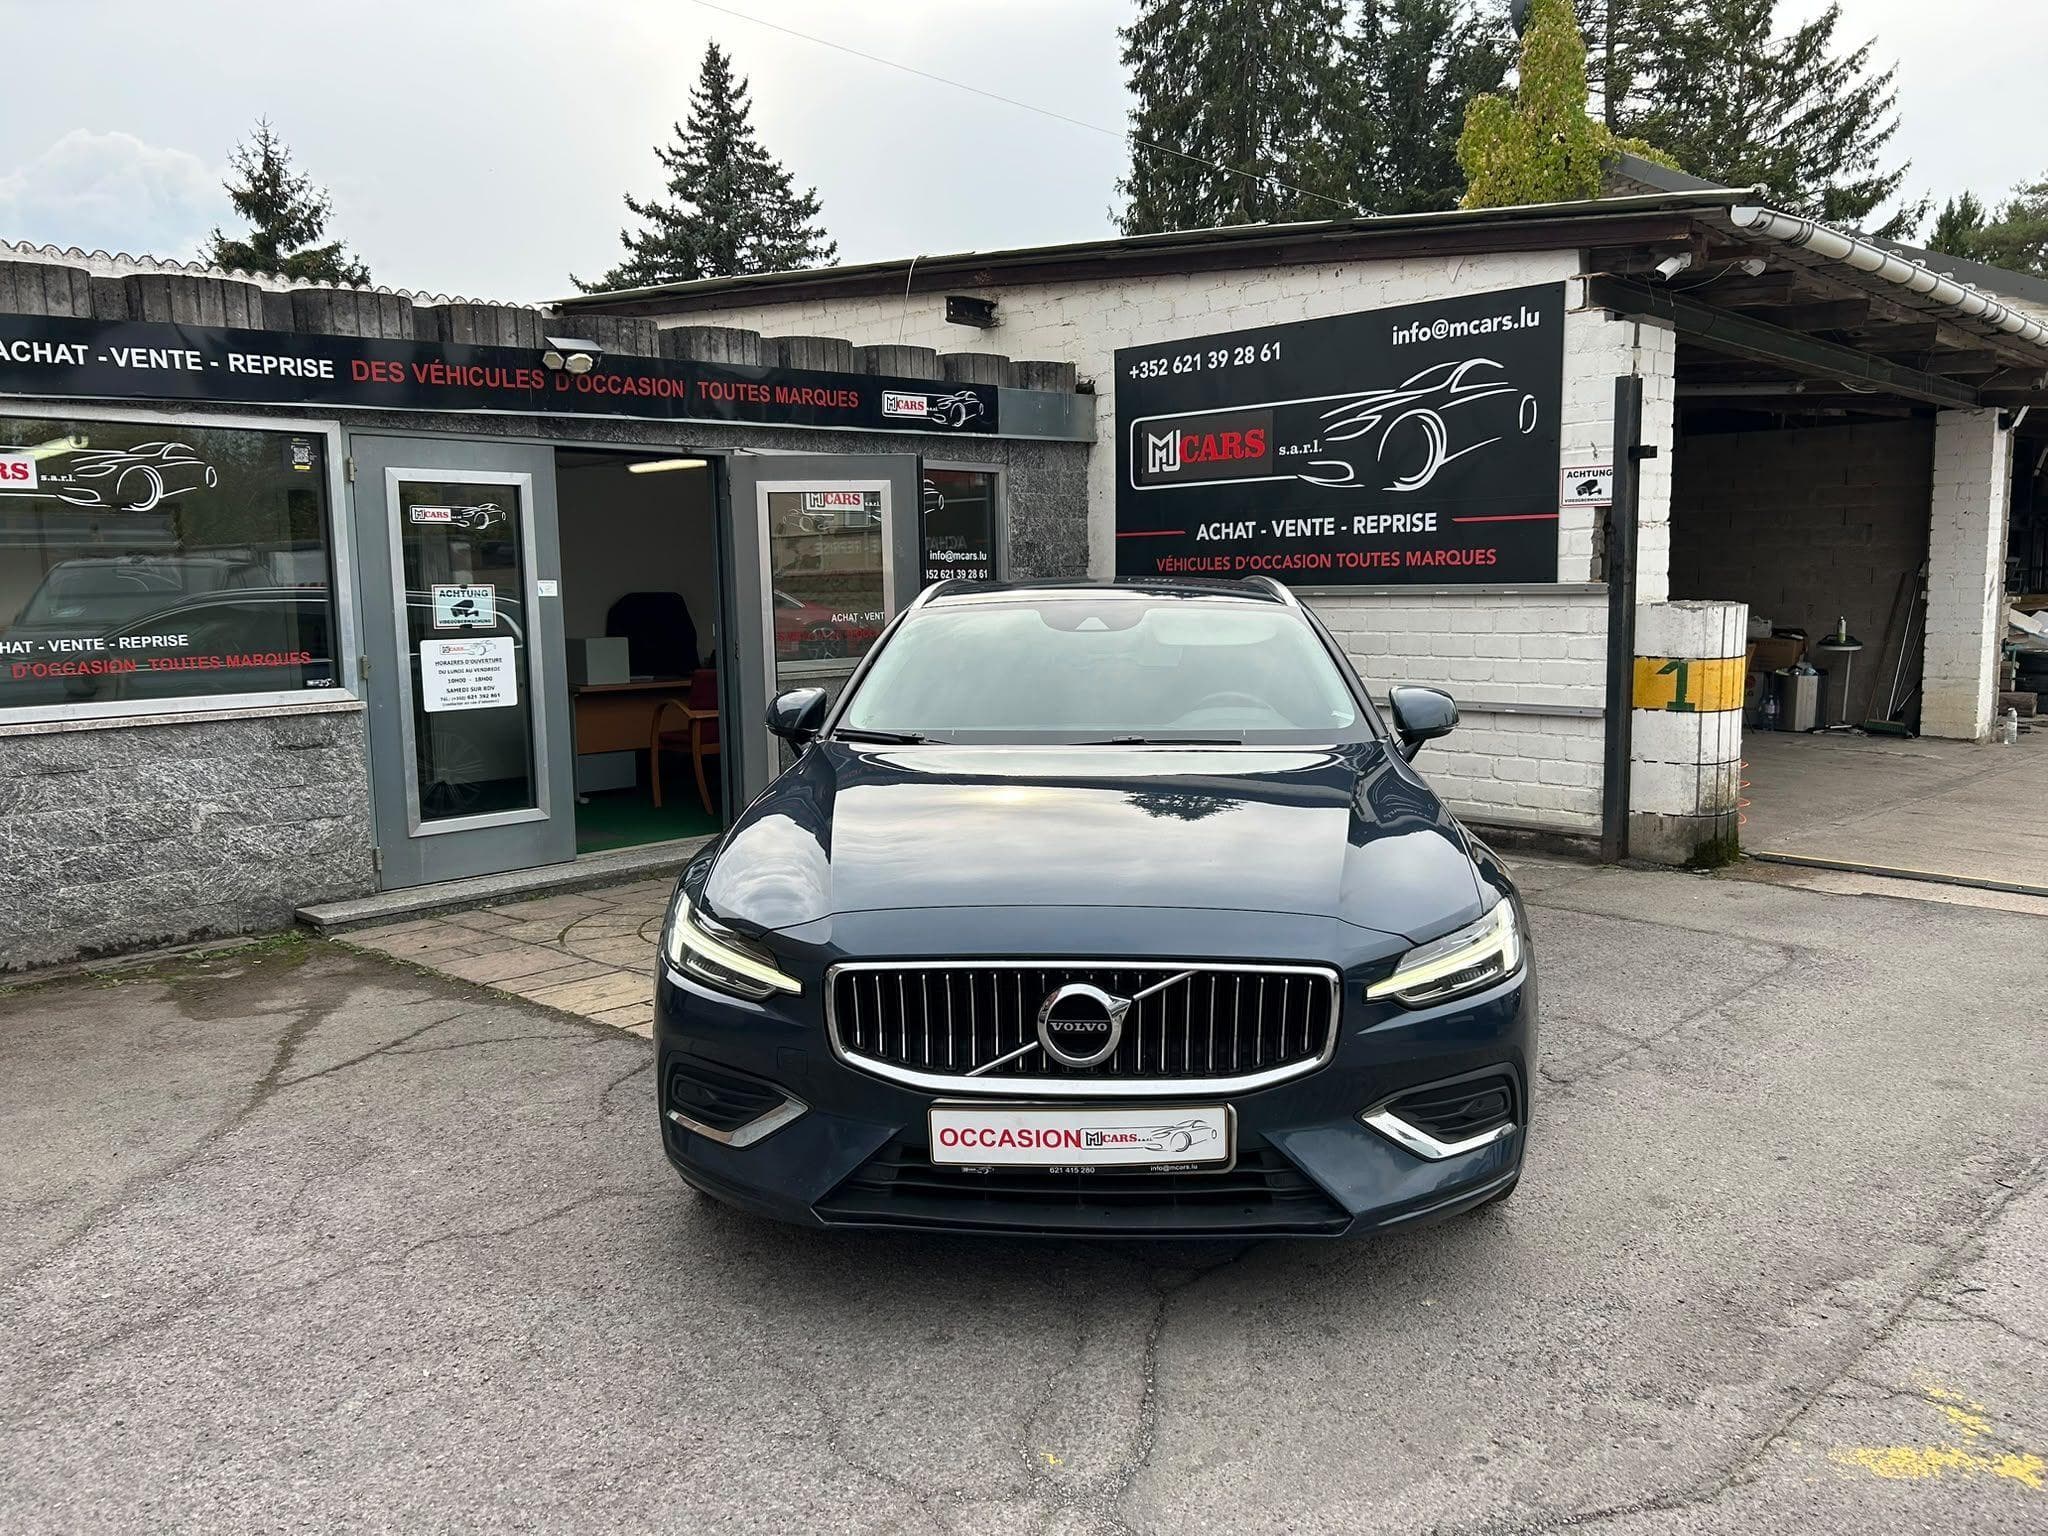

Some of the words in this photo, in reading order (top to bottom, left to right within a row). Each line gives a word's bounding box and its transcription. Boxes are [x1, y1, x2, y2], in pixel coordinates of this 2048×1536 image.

[1392, 306, 1540, 346] info@mcars.lu
[1129, 358, 1168, 379] +352
[1173, 353, 1201, 374] 621
[1207, 350, 1229, 369] 39
[1234, 346, 1255, 366] 28
[1260, 342, 1281, 362] 61
[228, 353, 335, 379] REPRISE
[351, 359, 405, 384] DES
[411, 358, 545, 389] VÉHICULES
[555, 373, 684, 398] D'OCCASION
[698, 381, 771, 403] TOUTES
[776, 386, 859, 408] MARQUES
[1278, 439, 1323, 456] s.a.r.l.
[40, 473, 77, 482] s.a.r.l.
[1566, 469, 1613, 479] ACHTUNG
[1195, 520, 1257, 541] ACHAT
[1271, 517, 1335, 538] VENTE
[1352, 512, 1438, 535] REPRISE
[929, 550, 988, 563] info@mcars.lu
[1156, 552, 1231, 572] VÉHICULES
[1235, 553, 1329, 571] D'OCCASION
[1336, 551, 1400, 569] TOUTES
[1406, 548, 1497, 567] MARQUES
[940, 569, 954, 579] 621
[956, 569, 966, 579] 39
[967, 569, 977, 579] 28
[978, 569, 988, 579] 61
[439, 589, 489, 598] ACHTUNG
[831, 612, 859, 622] ACHAT
[47, 638, 105, 652] VENTE
[119, 634, 189, 649] REPRISE
[12, 659, 136, 679] D'OCCASION
[147, 655, 221, 671] TOUTES
[226, 651, 312, 668] MARQUES
[1655, 661, 1696, 711] 1
[1050, 1022, 1108, 1032] VOLVO
[939, 1127, 1083, 1149] OCCASION
